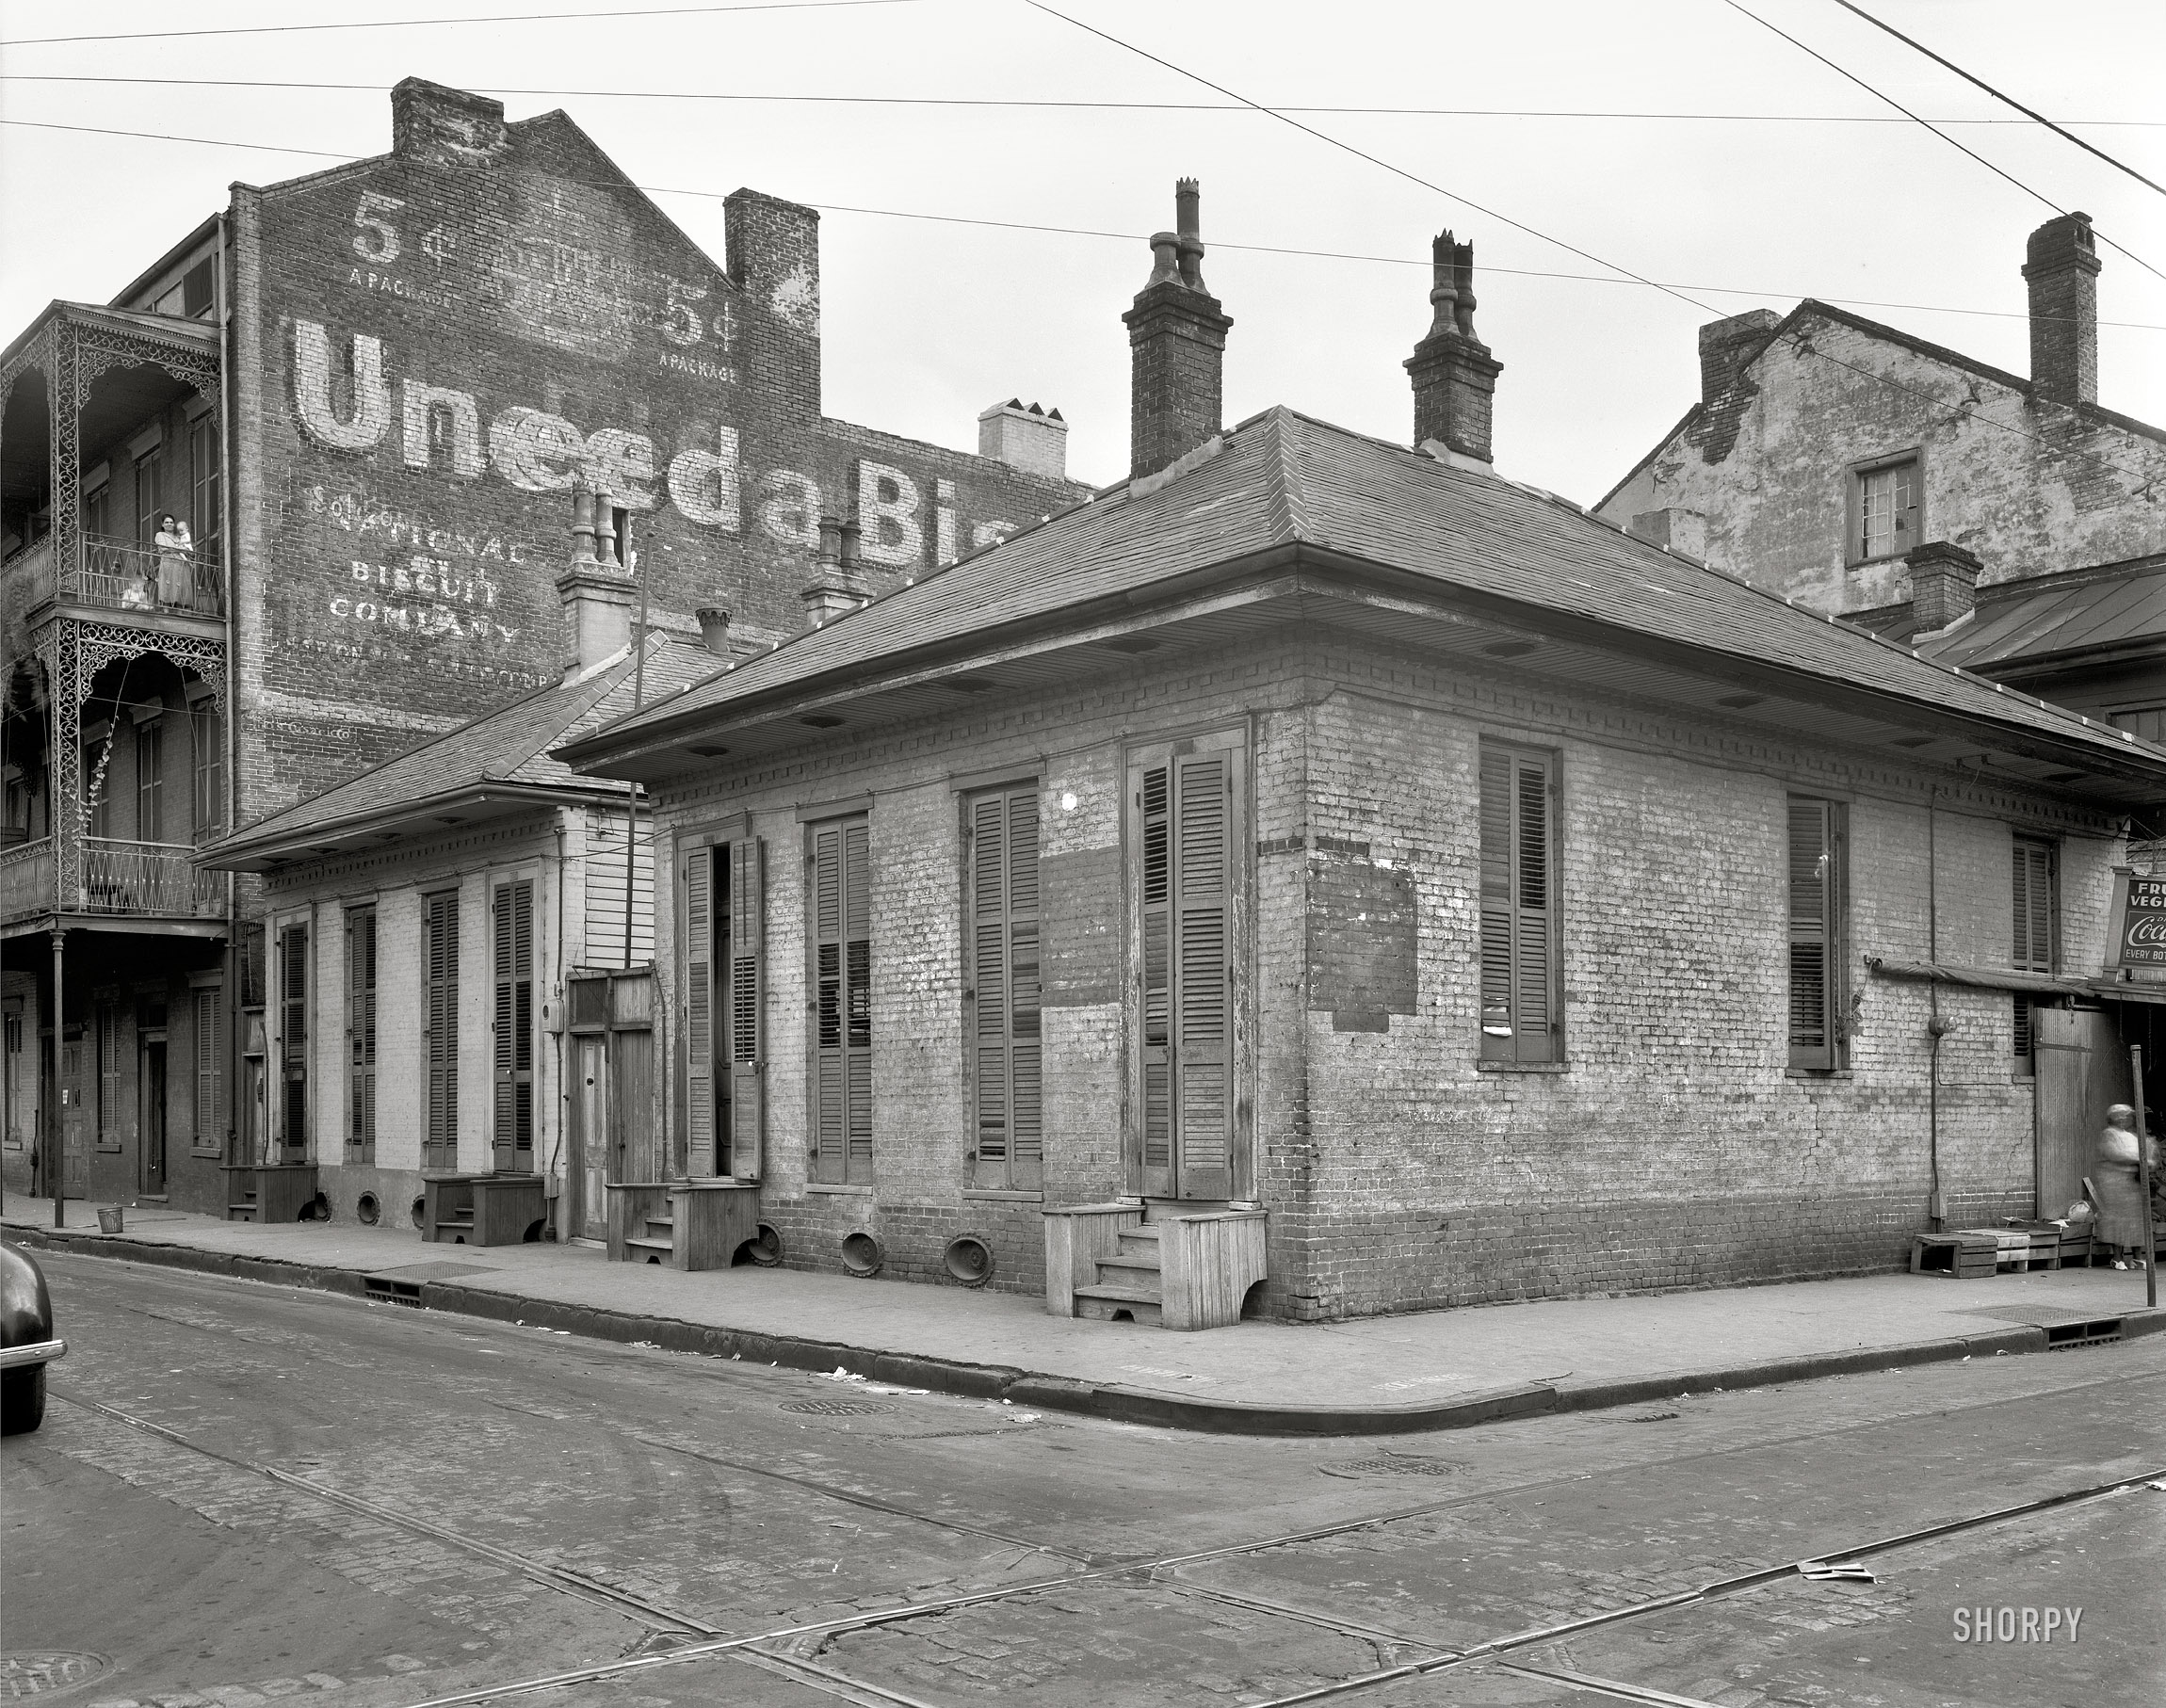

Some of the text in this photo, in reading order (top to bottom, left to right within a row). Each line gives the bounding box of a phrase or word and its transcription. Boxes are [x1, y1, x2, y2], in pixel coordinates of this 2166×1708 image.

[348, 268, 362, 285] A
[659, 351, 669, 366] A
[293, 317, 823, 552] Uneeda
[351, 560, 497, 605] BISCUIT
[330, 598, 520, 643] COMPANY
[2126, 949, 2150, 959] EVERY
